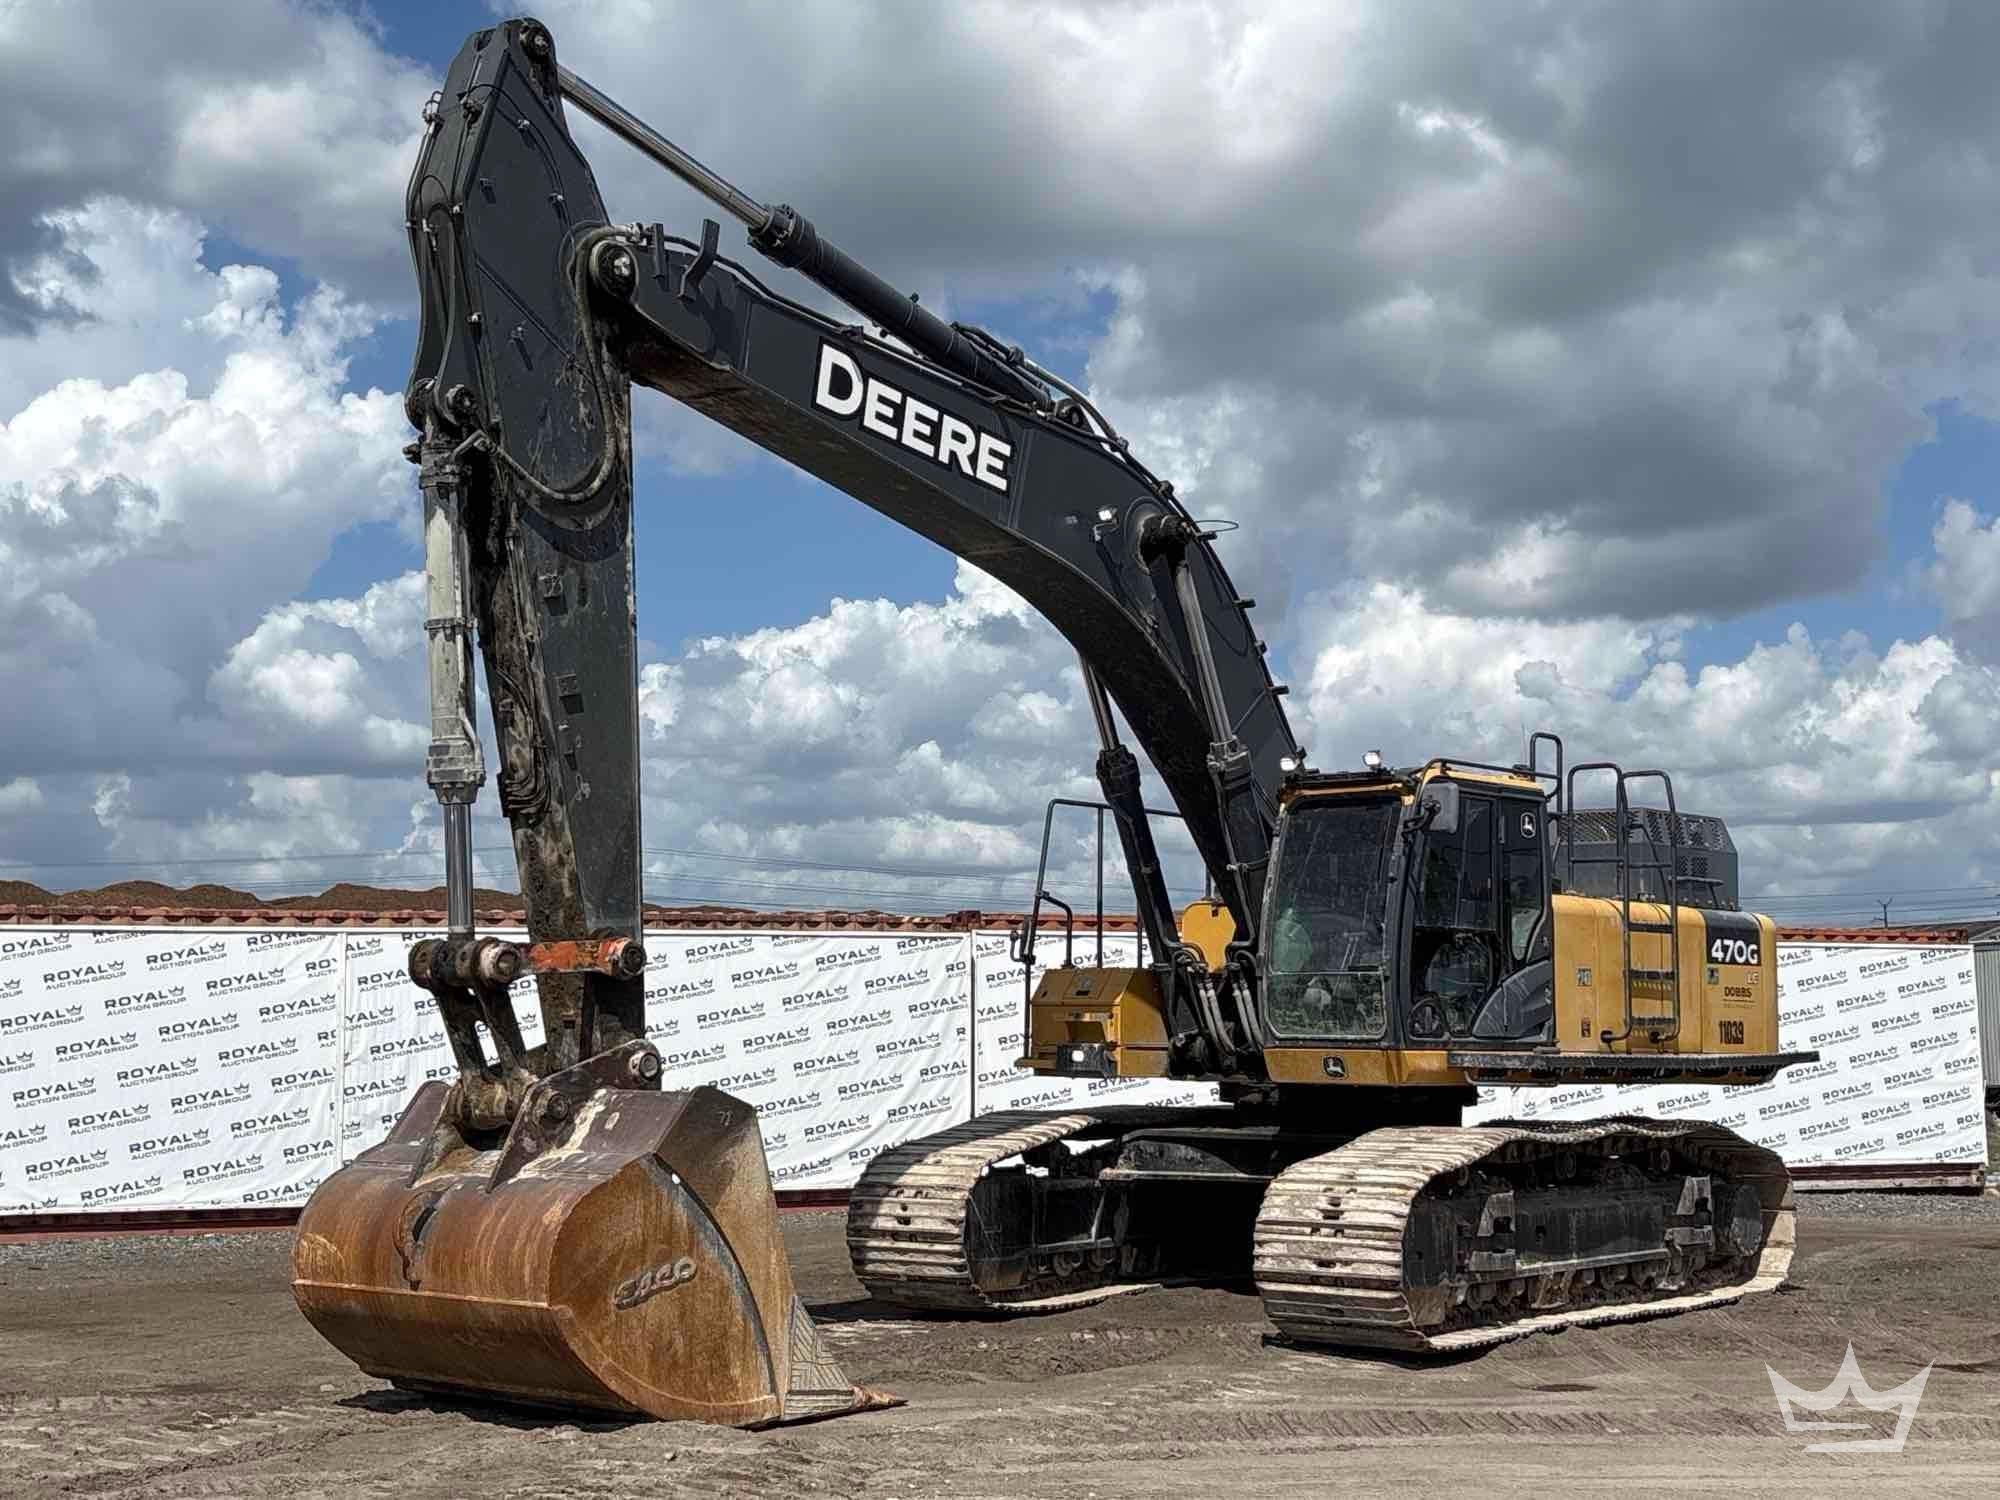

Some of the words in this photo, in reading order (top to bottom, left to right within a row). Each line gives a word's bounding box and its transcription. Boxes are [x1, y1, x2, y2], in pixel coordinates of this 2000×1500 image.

[816, 344, 1012, 490] DEERE
[147, 947, 209, 964] ROYAL
[686, 943, 739, 957] ROYAL
[816, 950, 867, 965] ROYAL
[1711, 938, 1758, 965] 470G
[149, 960, 192, 971] AUCTION
[1859, 959, 1898, 973] ROYAL
[44, 965, 108, 983] ROYAL
[206, 972, 268, 990] ROYAL
[732, 966, 784, 982] ROYAL
[865, 973, 915, 989] ROYAL
[1797, 973, 1837, 987] ROYAL
[46, 978, 90, 990] AUCTION
[209, 985, 251, 997] AUCTION
[645, 983, 697, 999] ROYAL
[1898, 980, 1936, 993] ROYAL
[782, 989, 834, 1006] ROYAL
[1724, 986, 1752, 998] DOBBS
[105, 991, 168, 1009] ROYAL
[259, 998, 320, 1016] ROYAL
[909, 997, 959, 1013] ROYAL
[1837, 994, 1876, 1008] ROYAL
[1932, 1000, 1967, 1015] ROYAL
[107, 1004, 150, 1016] AUCTION
[261, 1011, 303, 1023] AUCTION
[697, 1006, 751, 1023] ROYAL
[1, 1010, 66, 1028] ROYAL
[159, 1017, 222, 1036] ROYAL
[827, 1014, 878, 1030] ROYAL
[1871, 1015, 1910, 1029] ROYAL
[3, 1023, 47, 1035] AUCTION
[1719, 1020, 1744, 1045] 11039
[1810, 1029, 1849, 1043] ROYAL
[161, 1031, 204, 1043] AUCTION
[743, 1031, 796, 1048] ROYAL
[1910, 1035, 1948, 1049] ROYAL
[56, 1037, 120, 1055] ROYAL
[219, 1042, 281, 1061] ROYAL
[370, 1037, 429, 1054] ROYAL
[876, 1037, 927, 1053] ROYAL
[58, 1050, 102, 1062] AUCTION
[221, 1056, 263, 1068] AUCTION
[373, 1049, 413, 1061] AUCTION
[793, 1054, 845, 1071] ROYAL
[1849, 1049, 1888, 1063] ROYAL
[117, 1062, 181, 1081] ROYAL
[920, 1060, 967, 1077] ROYAL
[1787, 1064, 1826, 1080] ROYAL
[119, 1076, 163, 1088] AUCTION
[272, 1068, 332, 1087] ROYAL
[1884, 1070, 1922, 1084] ROYAL
[13, 1082, 78, 1101] ROYAL
[838, 1078, 889, 1095] ROYAL
[1822, 1085, 1862, 1100] ROYAL
[15, 1096, 60, 1108] AUCTION
[171, 1088, 234, 1107] ROYAL
[1011, 1091, 1060, 1108] ROYAL
[1550, 1091, 1592, 1104] ROYAL
[1657, 1095, 1699, 1109] ROYAL
[1922, 1090, 1960, 1104] ROYAL
[173, 1102, 216, 1114] AUCTION
[887, 1101, 938, 1117] ROYAL
[1759, 1100, 1799, 1115] ROYAL
[1861, 1105, 1900, 1120] ROYAL
[68, 1109, 133, 1128] ROYAL
[231, 1113, 293, 1132] ROYAL
[71, 1122, 114, 1135] AUCTION
[233, 1126, 275, 1139] AUCTION
[805, 1119, 856, 1136] ROYAL
[1799, 1120, 1839, 1135] ROYAL
[1896, 1126, 1935, 1140] ROYAL
[130, 1134, 193, 1153] ROYAL
[1834, 1141, 1874, 1156] ROYAL
[132, 1147, 175, 1160] AUCTION
[1935, 1145, 1973, 1161] ROYAL
[26, 1155, 91, 1174] ROYAL
[183, 1160, 246, 1179] ROYAL
[28, 1169, 72, 1181] AUCTION
[186, 1173, 228, 1186] AUCTION
[81, 1181, 145, 1201] ROYAL
[243, 1182, 305, 1203] ROYAL
[83, 1195, 127, 1207] AUCTION
